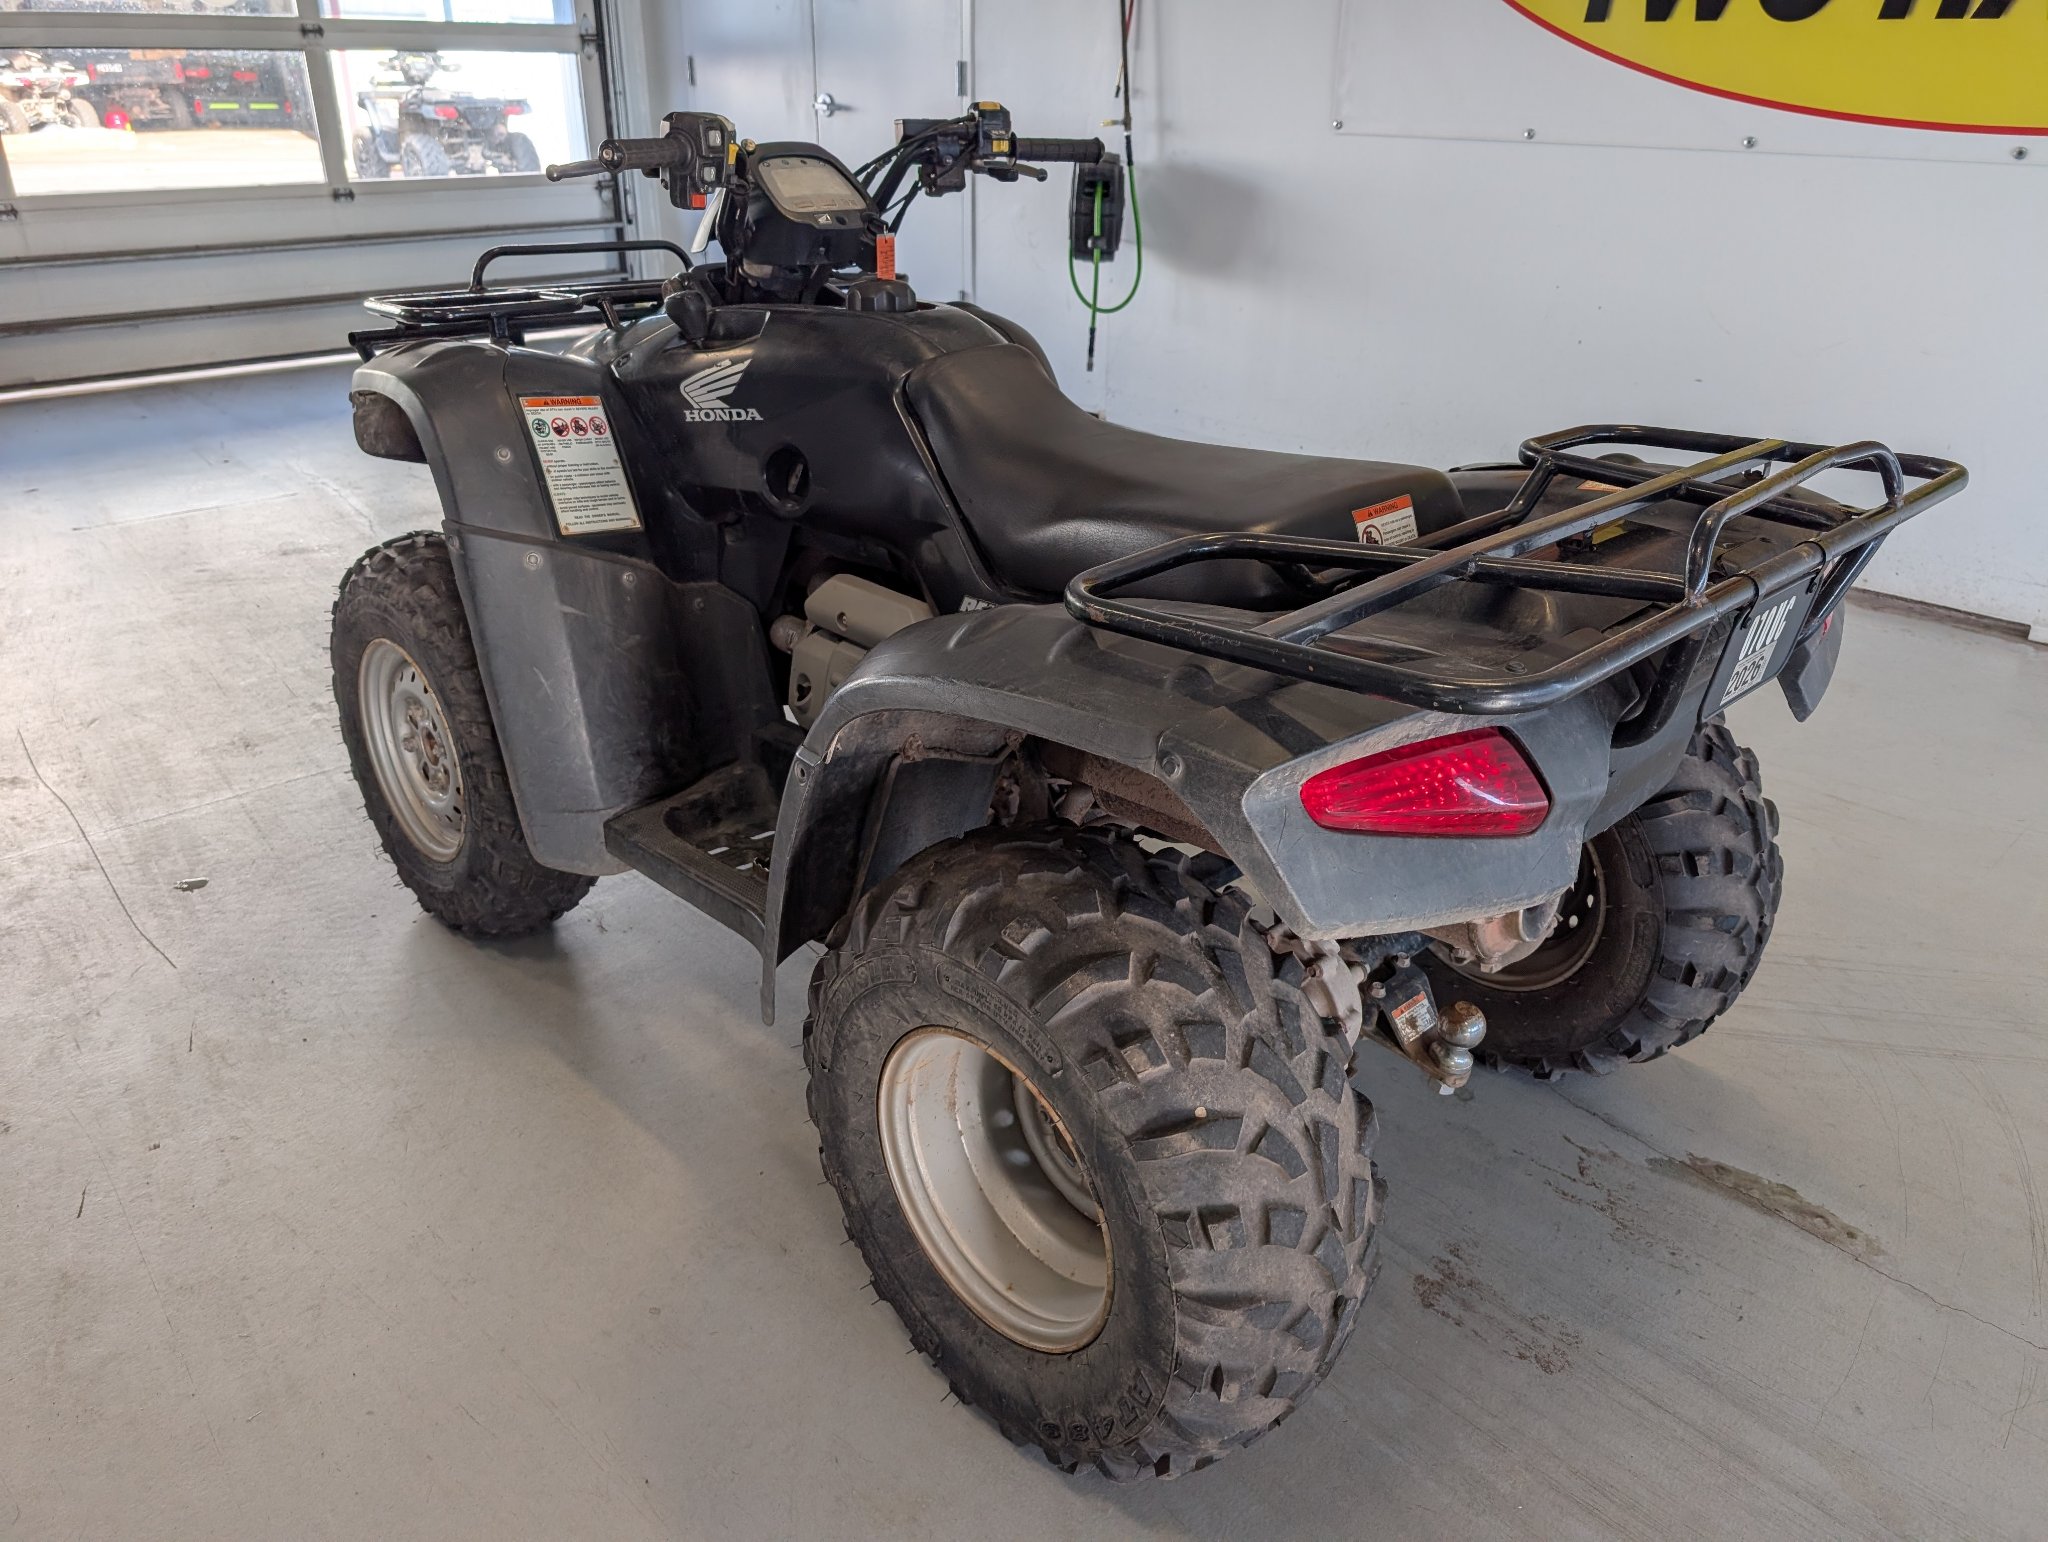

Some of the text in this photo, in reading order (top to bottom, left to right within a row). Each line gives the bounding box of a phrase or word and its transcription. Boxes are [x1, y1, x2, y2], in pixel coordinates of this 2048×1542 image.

[551, 398, 582, 406] WARNING
[684, 408, 764, 422] HONDA
[1372, 502, 1398, 515] WARNING
[1724, 655, 1765, 697] 2026
